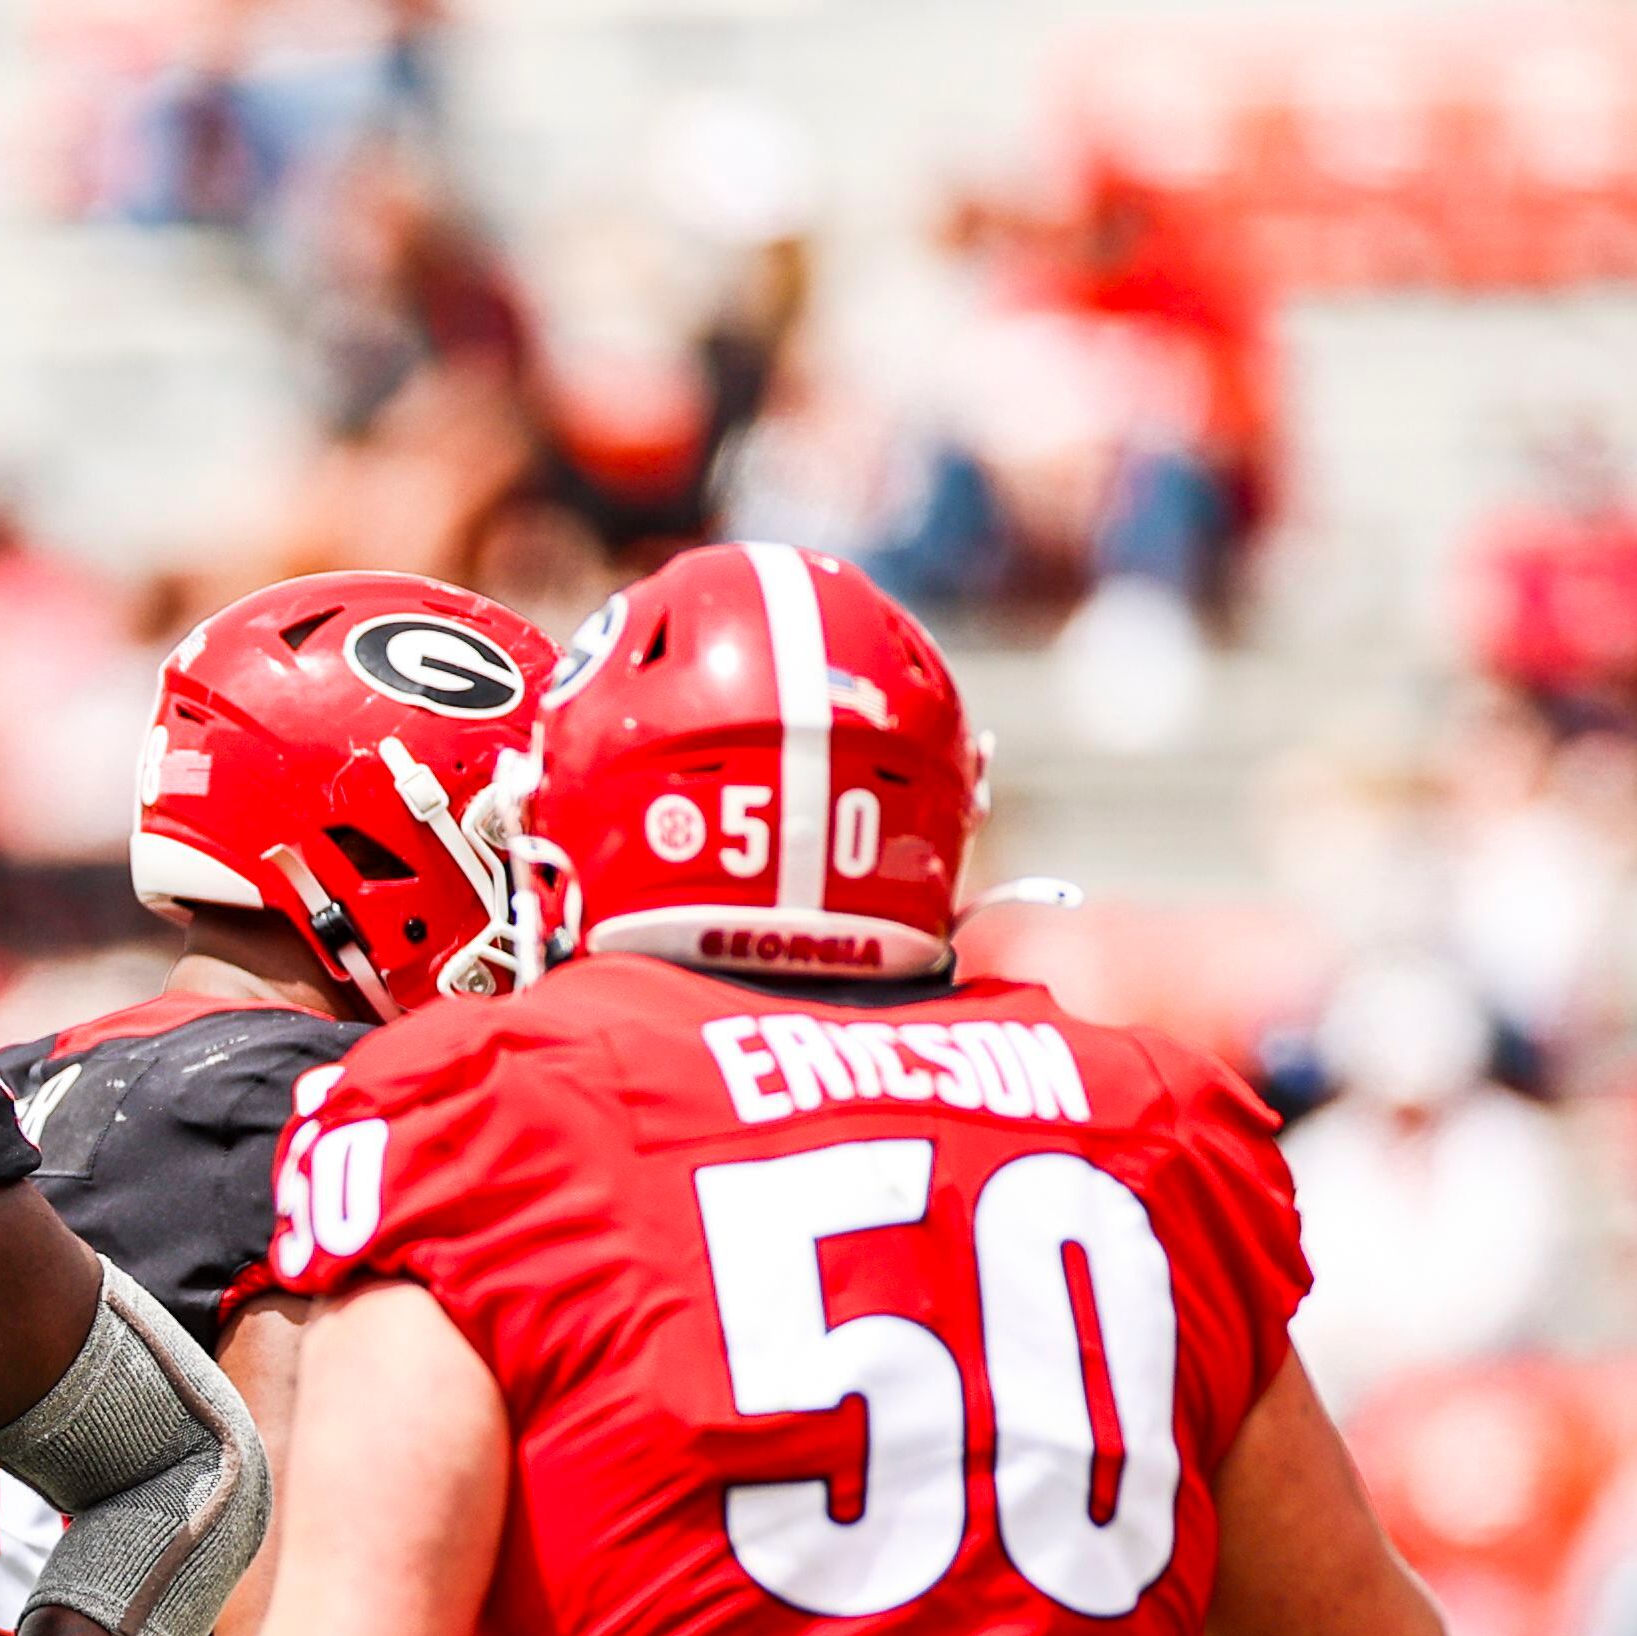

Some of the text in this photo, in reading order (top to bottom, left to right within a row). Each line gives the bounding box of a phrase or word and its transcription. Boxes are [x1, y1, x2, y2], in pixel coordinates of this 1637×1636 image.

[352, 620, 519, 710] G
[701, 929, 881, 966] GEORGIA
[703, 1013, 1092, 1124] ERICSON
[694, 1137, 1181, 1618] 50
